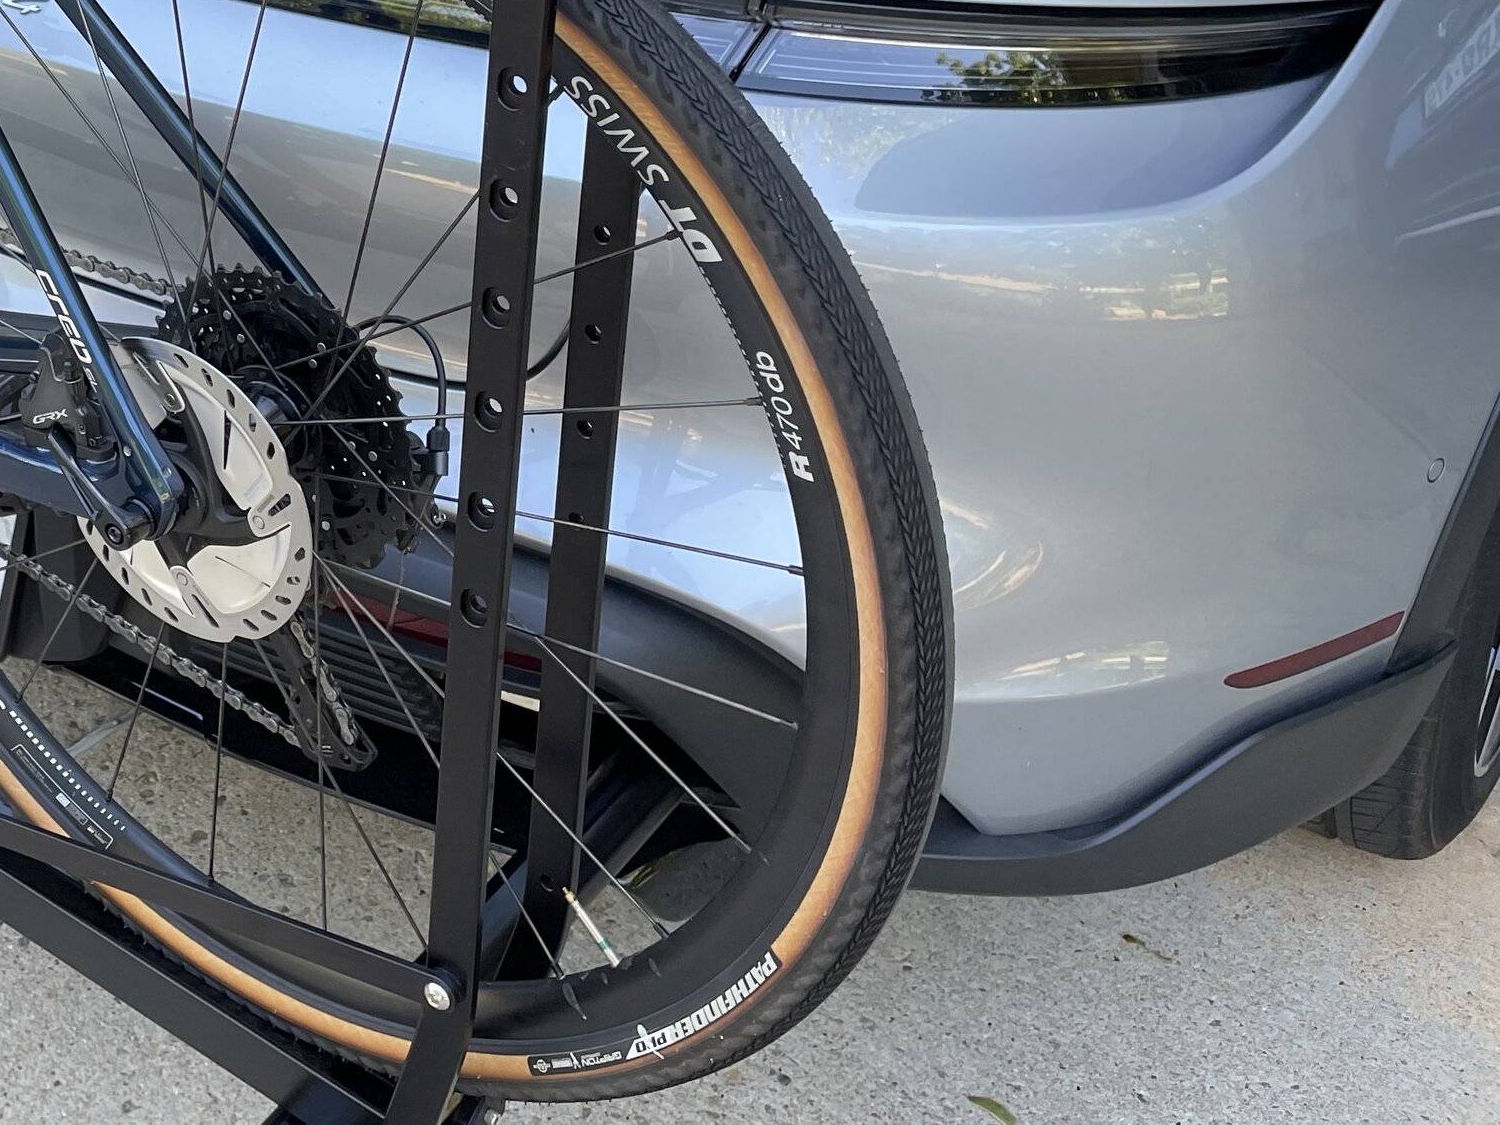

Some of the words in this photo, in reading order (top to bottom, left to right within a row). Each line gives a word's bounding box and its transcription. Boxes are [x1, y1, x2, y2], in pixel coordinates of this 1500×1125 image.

[563, 76, 669, 186] SWISS
[658, 199, 723, 263] DT
[32, 408, 69, 425] GRX
